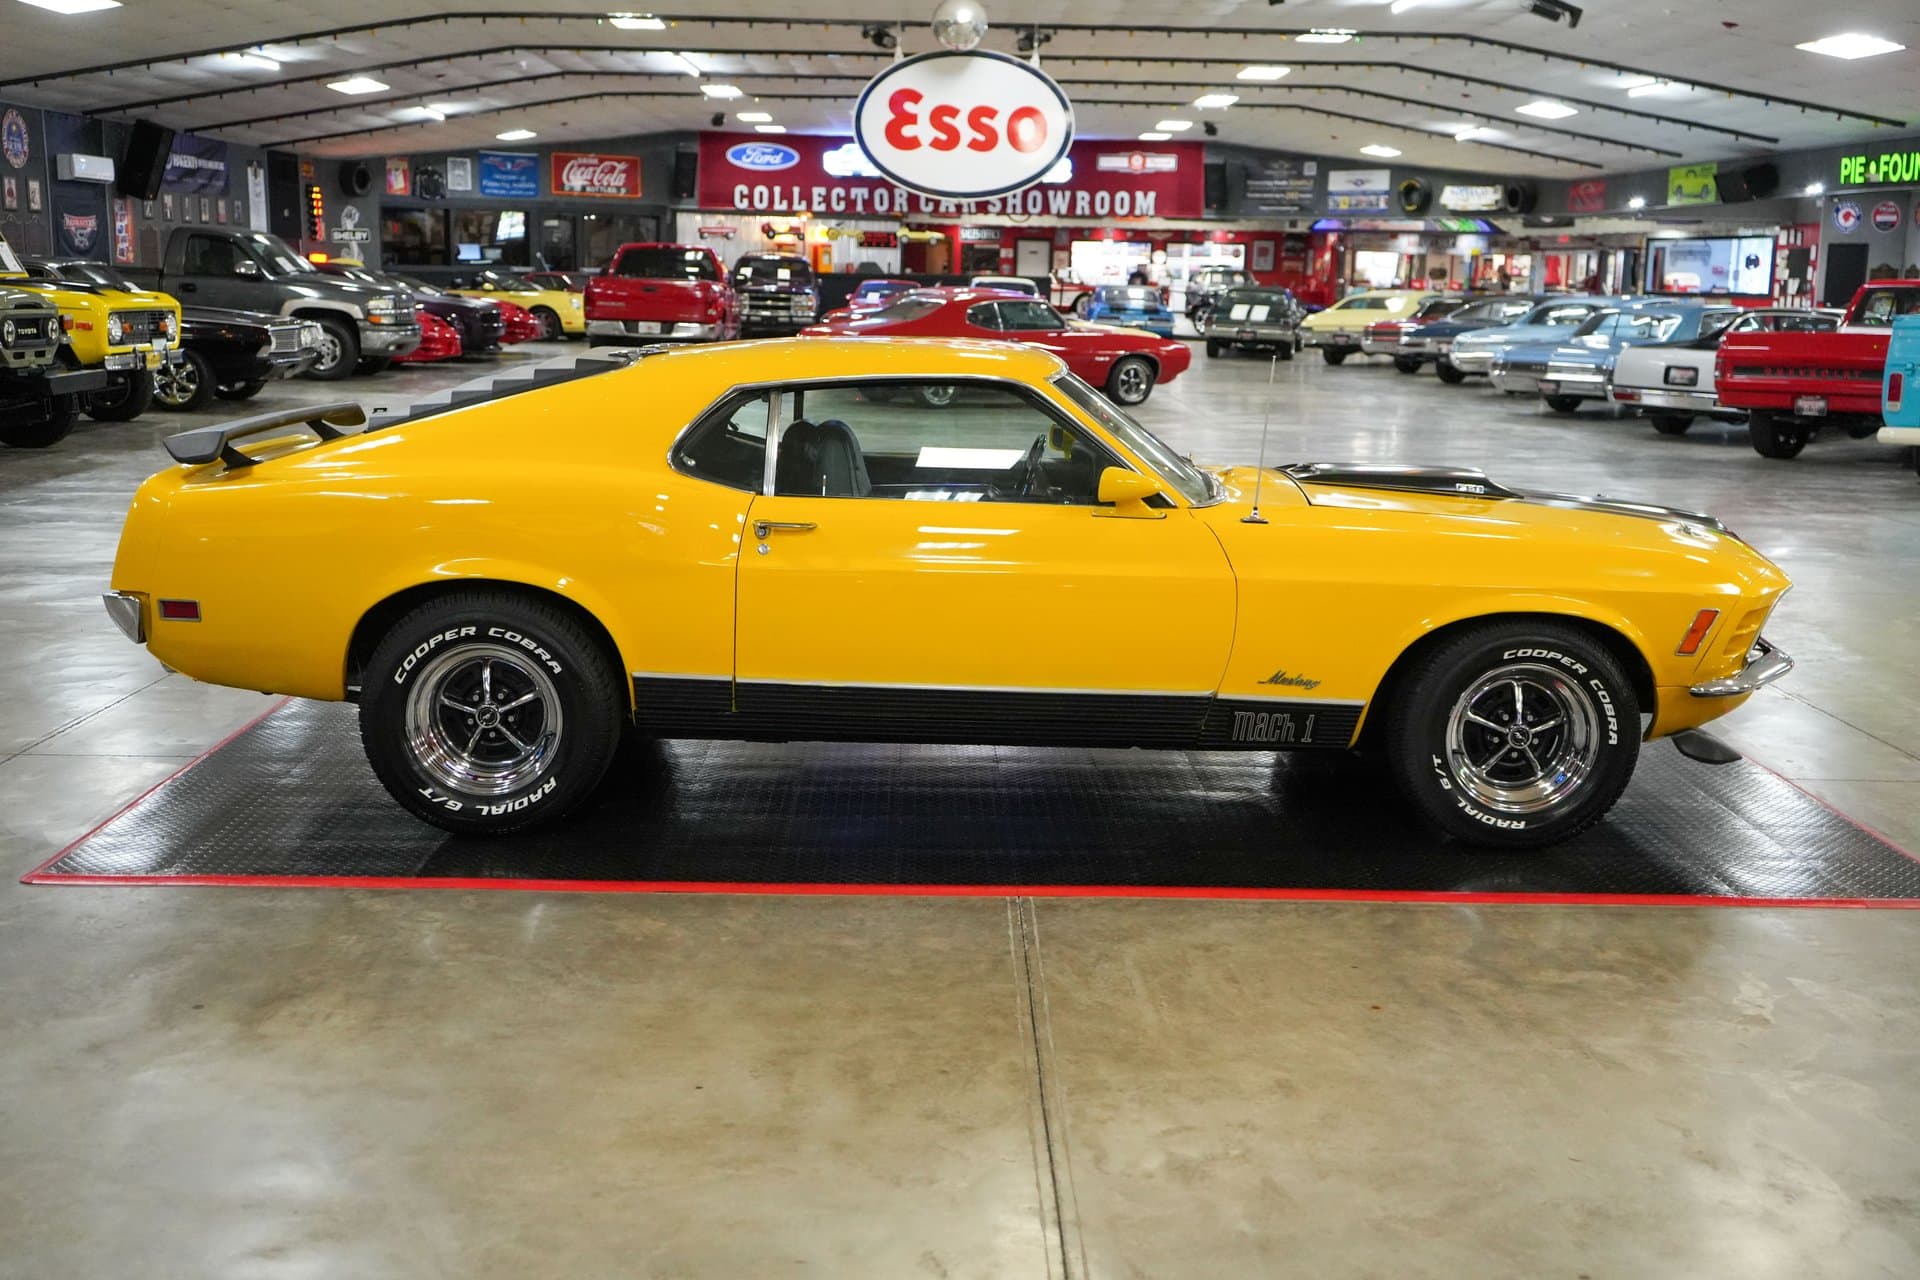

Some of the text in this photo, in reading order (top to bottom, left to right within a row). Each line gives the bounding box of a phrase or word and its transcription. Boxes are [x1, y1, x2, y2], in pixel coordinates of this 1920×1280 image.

[742, 146, 784, 165] Ford
[1840, 156, 1866, 184] PIE
[733, 184, 908, 213] COLLECTOR
[987, 190, 1157, 216] SHOWROOM
[394, 626, 562, 684] COOPER COBRA
[1257, 670, 1321, 690] Mustang
[1503, 649, 1618, 745] COOPER COBRA
[1301, 714, 1315, 743] 1
[418, 776, 557, 815] RADIAL G/T
[1432, 754, 1526, 829] RADIAL G/T
